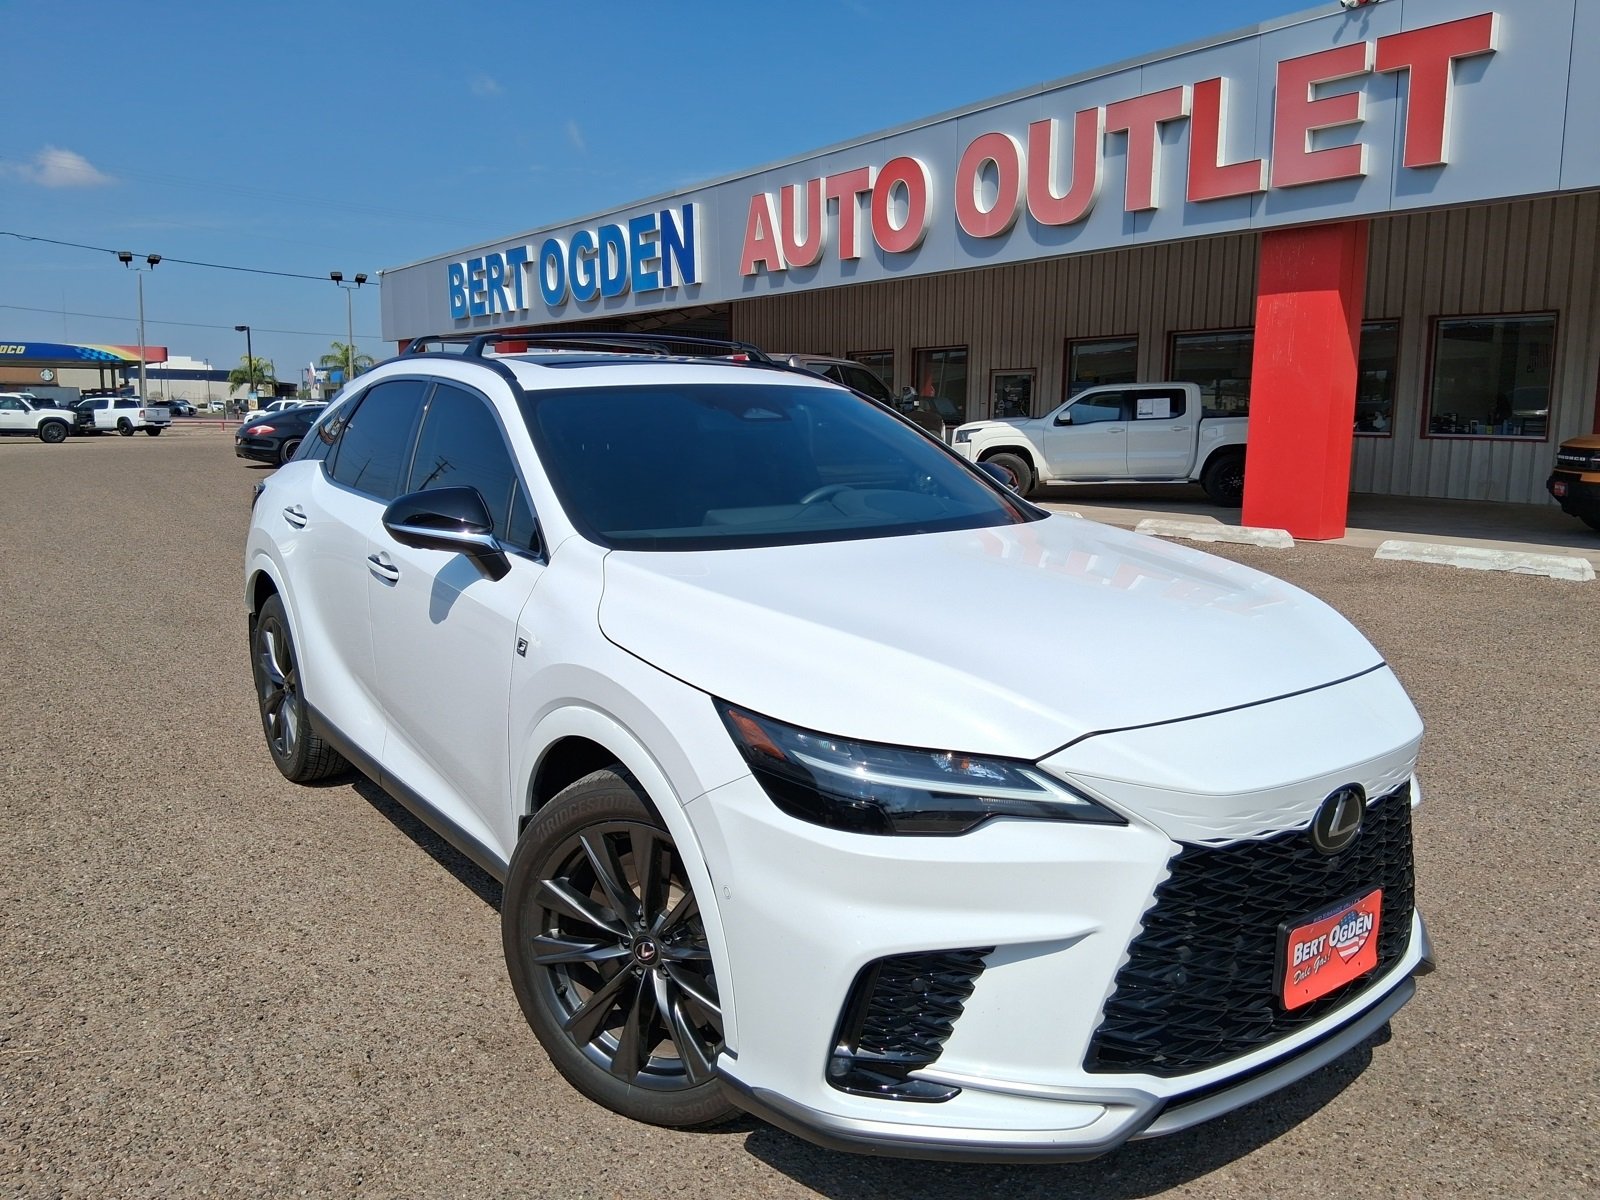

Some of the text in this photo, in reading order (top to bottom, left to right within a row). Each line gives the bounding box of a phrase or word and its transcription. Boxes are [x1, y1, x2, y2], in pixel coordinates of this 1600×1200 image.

[447, 12, 1500, 319] BERT OGDEN AUTO OUTLET
[1293, 912, 1373, 967] BERT OGDEN
